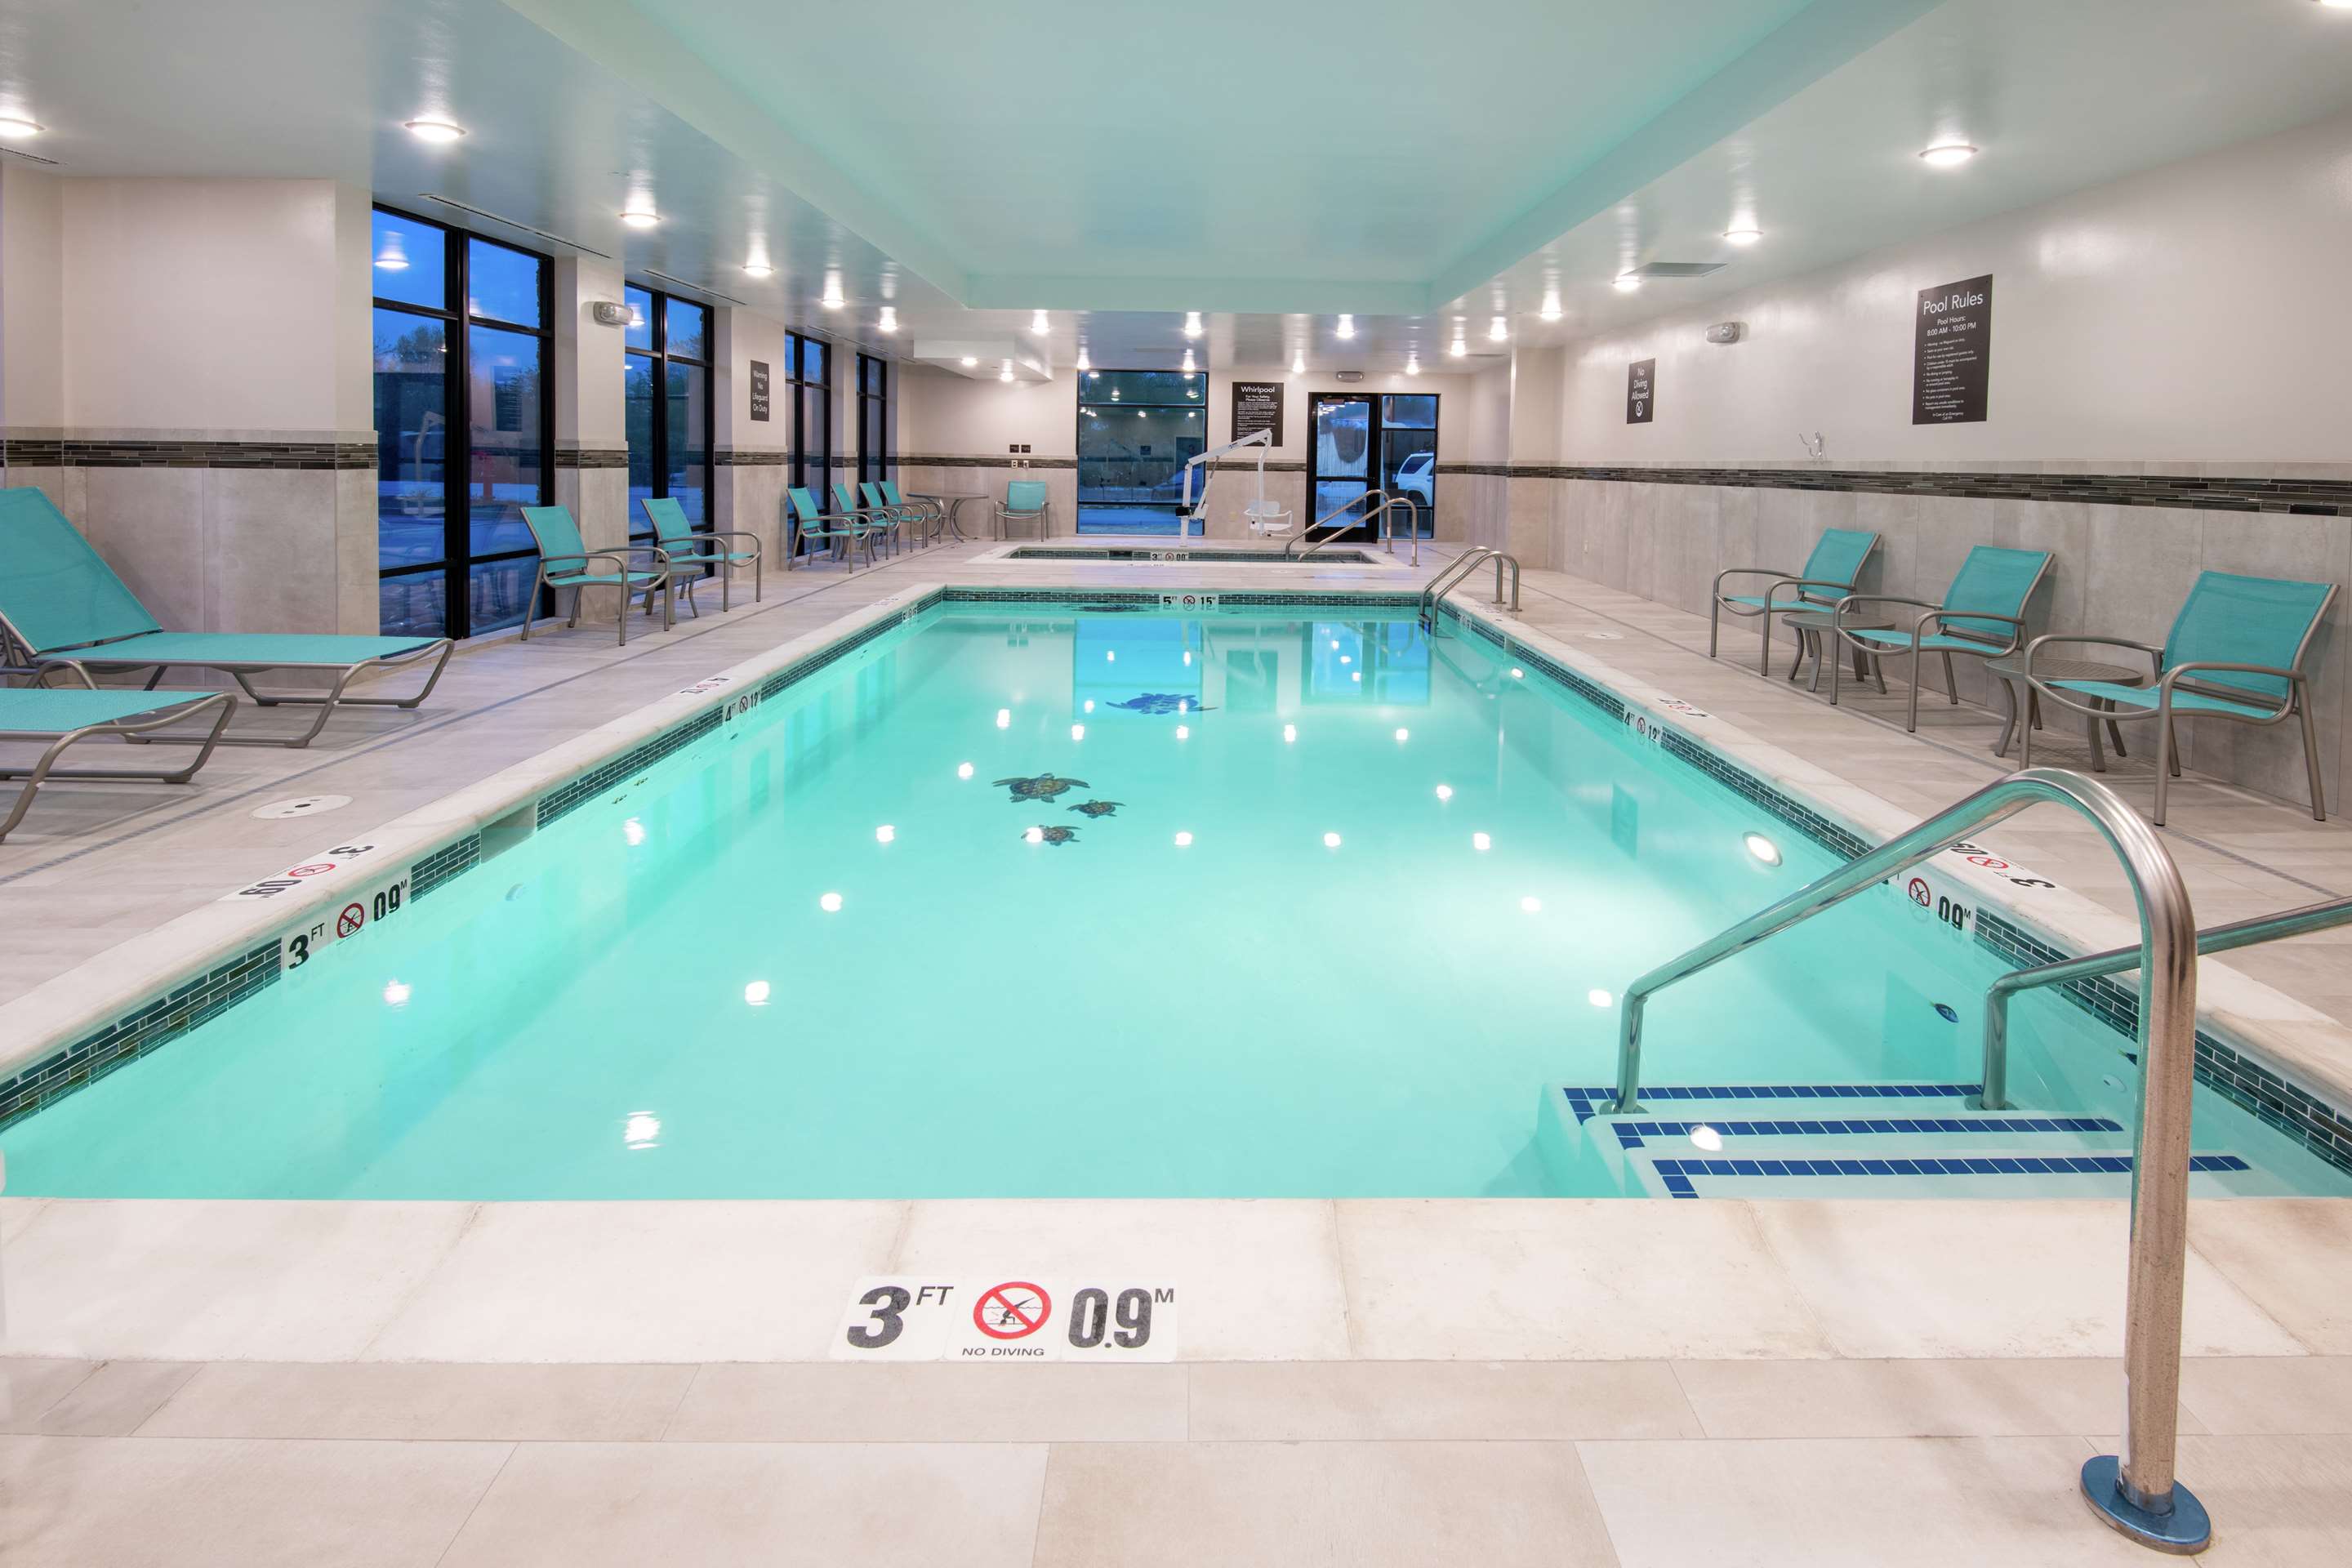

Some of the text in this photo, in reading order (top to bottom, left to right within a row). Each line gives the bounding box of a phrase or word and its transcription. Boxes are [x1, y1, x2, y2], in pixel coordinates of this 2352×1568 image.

[1923, 291, 1984, 315] Pool Rules
[1953, 323, 1967, 332] 10:00
[1637, 367, 1645, 376] No
[1633, 378, 1647, 390] Diving
[1241, 386, 1275, 394] Whirlpool
[1632, 389, 1649, 400] Allowed
[288, 934, 310, 969] 3
[311, 923, 325, 942] FT
[847, 1285, 1174, 1349] 3 FT 0.9 M
[962, 1347, 1045, 1356] NO DIVING
